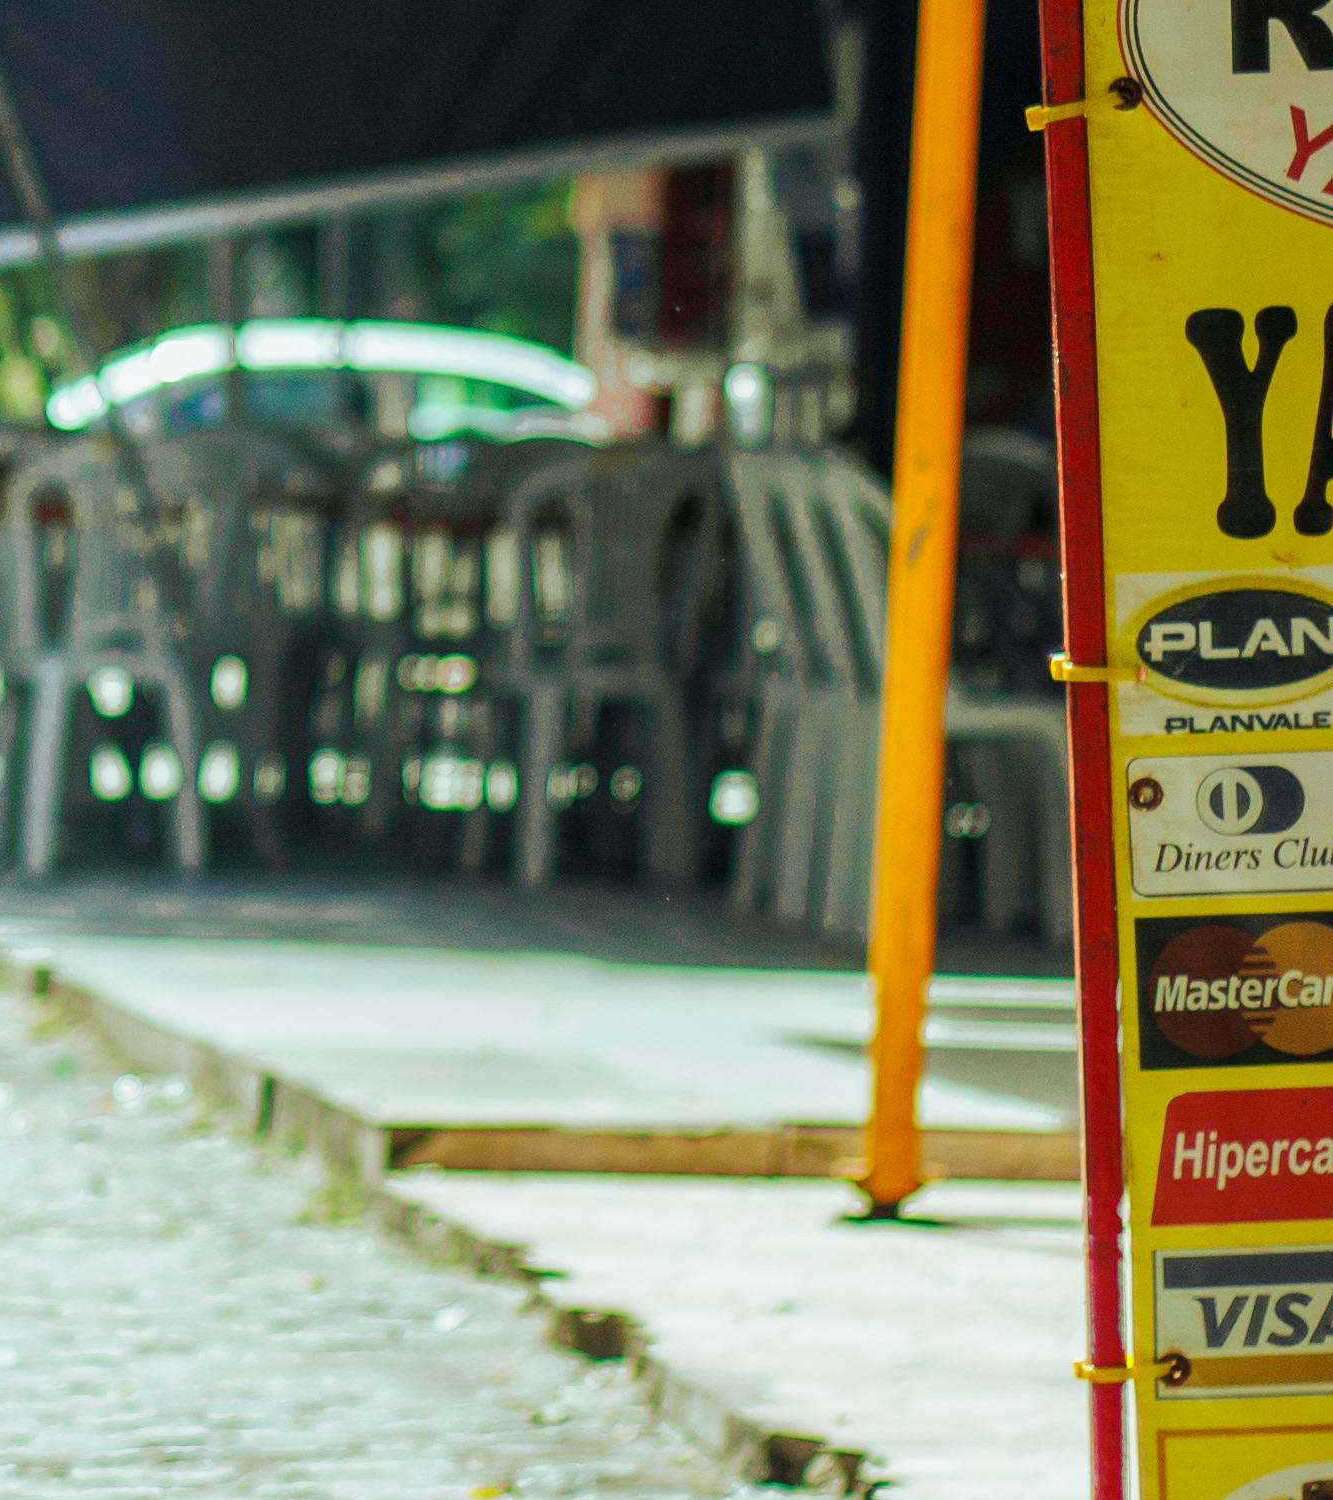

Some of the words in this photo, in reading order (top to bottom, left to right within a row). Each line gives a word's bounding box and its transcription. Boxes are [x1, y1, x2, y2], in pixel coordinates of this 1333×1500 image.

[1143, 616, 1333, 662] PLAN
[1164, 711, 1332, 734] PLANVALE
[1155, 842, 1262, 874] Diners
[1273, 837, 1333, 869] Clu
[1172, 1129, 1333, 1191] Hiperca
